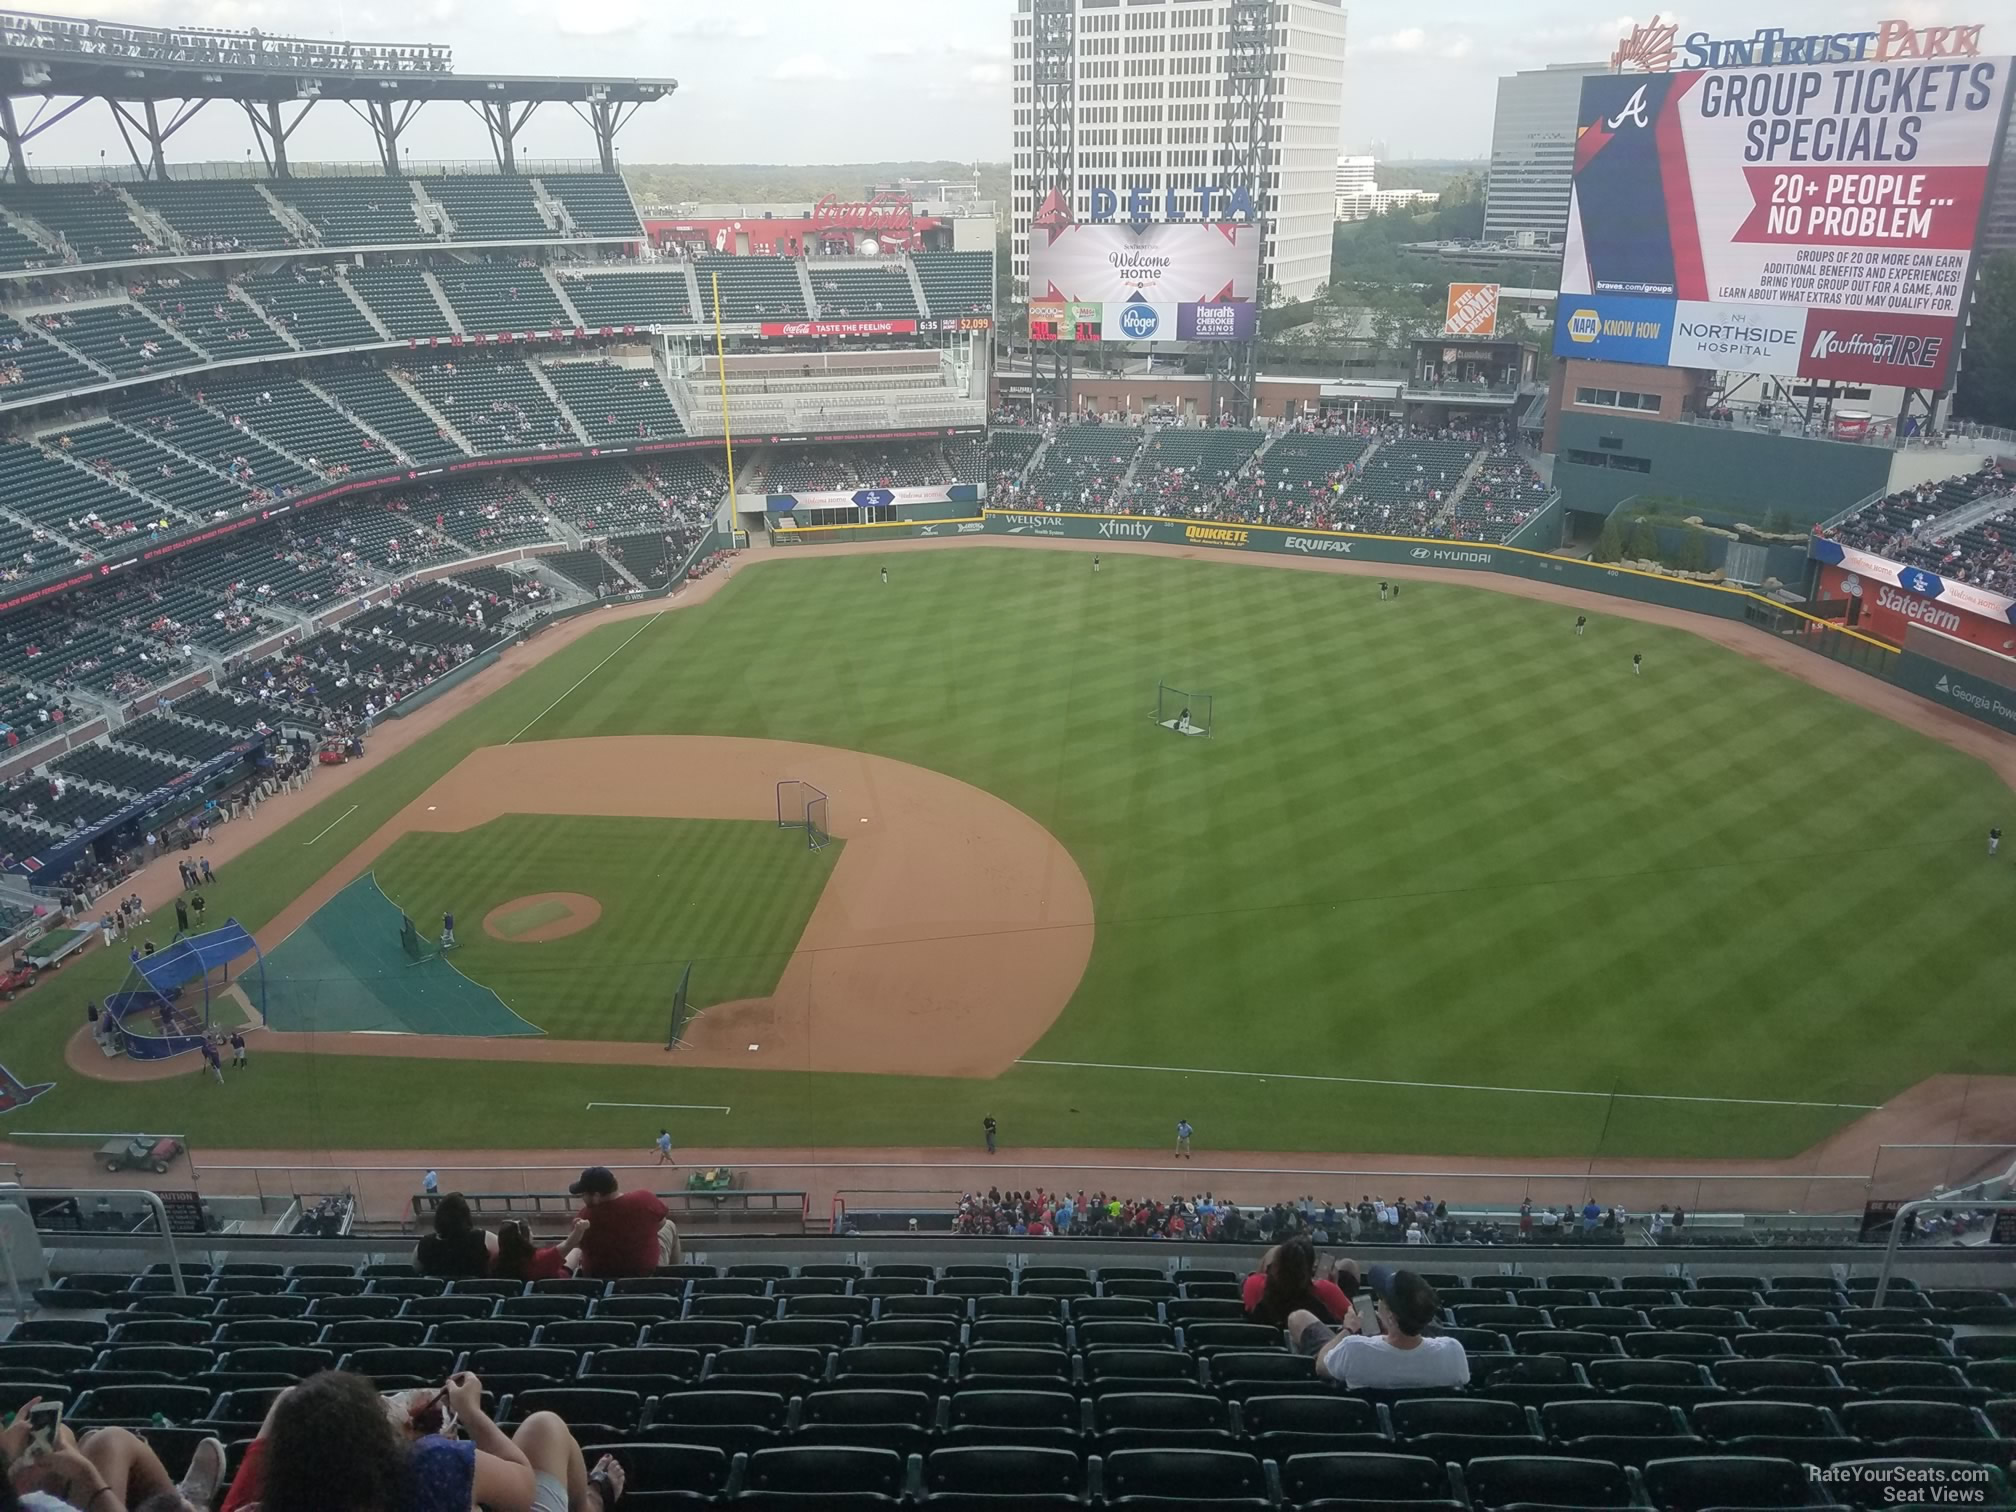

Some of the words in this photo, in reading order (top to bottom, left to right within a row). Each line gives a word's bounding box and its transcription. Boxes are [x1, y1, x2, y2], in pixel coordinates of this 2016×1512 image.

[1700, 71, 1822, 118] GROUP
[1832, 62, 1995, 115] TICKETS
[1744, 115, 1922, 162] SPECIALS
[1772, 174, 1818, 203] 20+
[1825, 174, 1926, 206] PEOPLE
[1091, 186, 1256, 219] DELTA
[1767, 205, 1802, 235] NO
[1807, 206, 1932, 238] PROBLEM
[1109, 250, 1171, 268] Welcome
[1796, 250, 1834, 263] GROUPS
[1836, 252, 1849, 264] OF
[1851, 252, 1863, 264] 20
[1865, 252, 1879, 265] OR
[1881, 253, 1911, 266] MORE
[1912, 254, 1933, 267] CAN
[1935, 255, 1963, 268] EARN
[1763, 263, 1818, 276] ADDITIONAL
[1819, 264, 1864, 278] BENEFITS
[1866, 266, 1887, 279] AND
[1888, 267, 1961, 283] EXPERIENCES!
[1597, 281, 1673, 293] braves.com/groups
[1760, 276, 1789, 288] BRING
[1790, 277, 1816, 289] YOUR
[1816, 278, 1849, 291] GROUP
[1851, 279, 1870, 291] OUT
[1872, 281, 1890, 293] FOR
[1892, 282, 1900, 293] A
[1901, 283, 1932, 297] GAME,
[1935, 284, 1957, 297] AND
[1447, 284, 1498, 333] HOME
[1453, 288, 1475, 309] THE
[1719, 286, 1747, 298] LEARN
[1748, 287, 1778, 300] ABOUT
[1779, 289, 1806, 302] WHAT
[1807, 291, 1842, 304] EXTRAS
[1844, 293, 1863, 305] YOU
[1864, 294, 1887, 307] MAY
[1888, 295, 1930, 309] QUALIFY
[1931, 298, 1954, 311] FOR.
[1123, 309, 1156, 335] Kroger
[1196, 306, 1234, 318] Harrah's
[1196, 317, 1234, 325] CHEROKEE
[1464, 302, 1496, 333] DEPOT
[1732, 314, 1746, 323] NH
[648, 323, 662, 335] 42
[816, 324, 840, 332] TASTE
[858, 323, 891, 331] FEELING
[920, 321, 938, 330] 6:35
[961, 318, 989, 330] $2,099
[1572, 317, 1597, 335] NAPA
[1603, 319, 1633, 337] KNOW
[1636, 322, 1661, 340] HOW
[1679, 323, 1798, 345] NORTHSIDE
[1697, 341, 1771, 357] HOSPITAL
[1810, 330, 1895, 359] Kauffman
[1872, 333, 1943, 368] TIRE
[1005, 515, 1064, 527] WELLSTAR
[1098, 519, 1153, 539] xfinity
[1185, 525, 1249, 542] QUIKRETE
[1284, 536, 1351, 553] EQUIFAX
[1433, 550, 1491, 564] HYUNDAI
[1952, 684, 1991, 709] Georgia
[160, 1192, 193, 1201] AUTION
